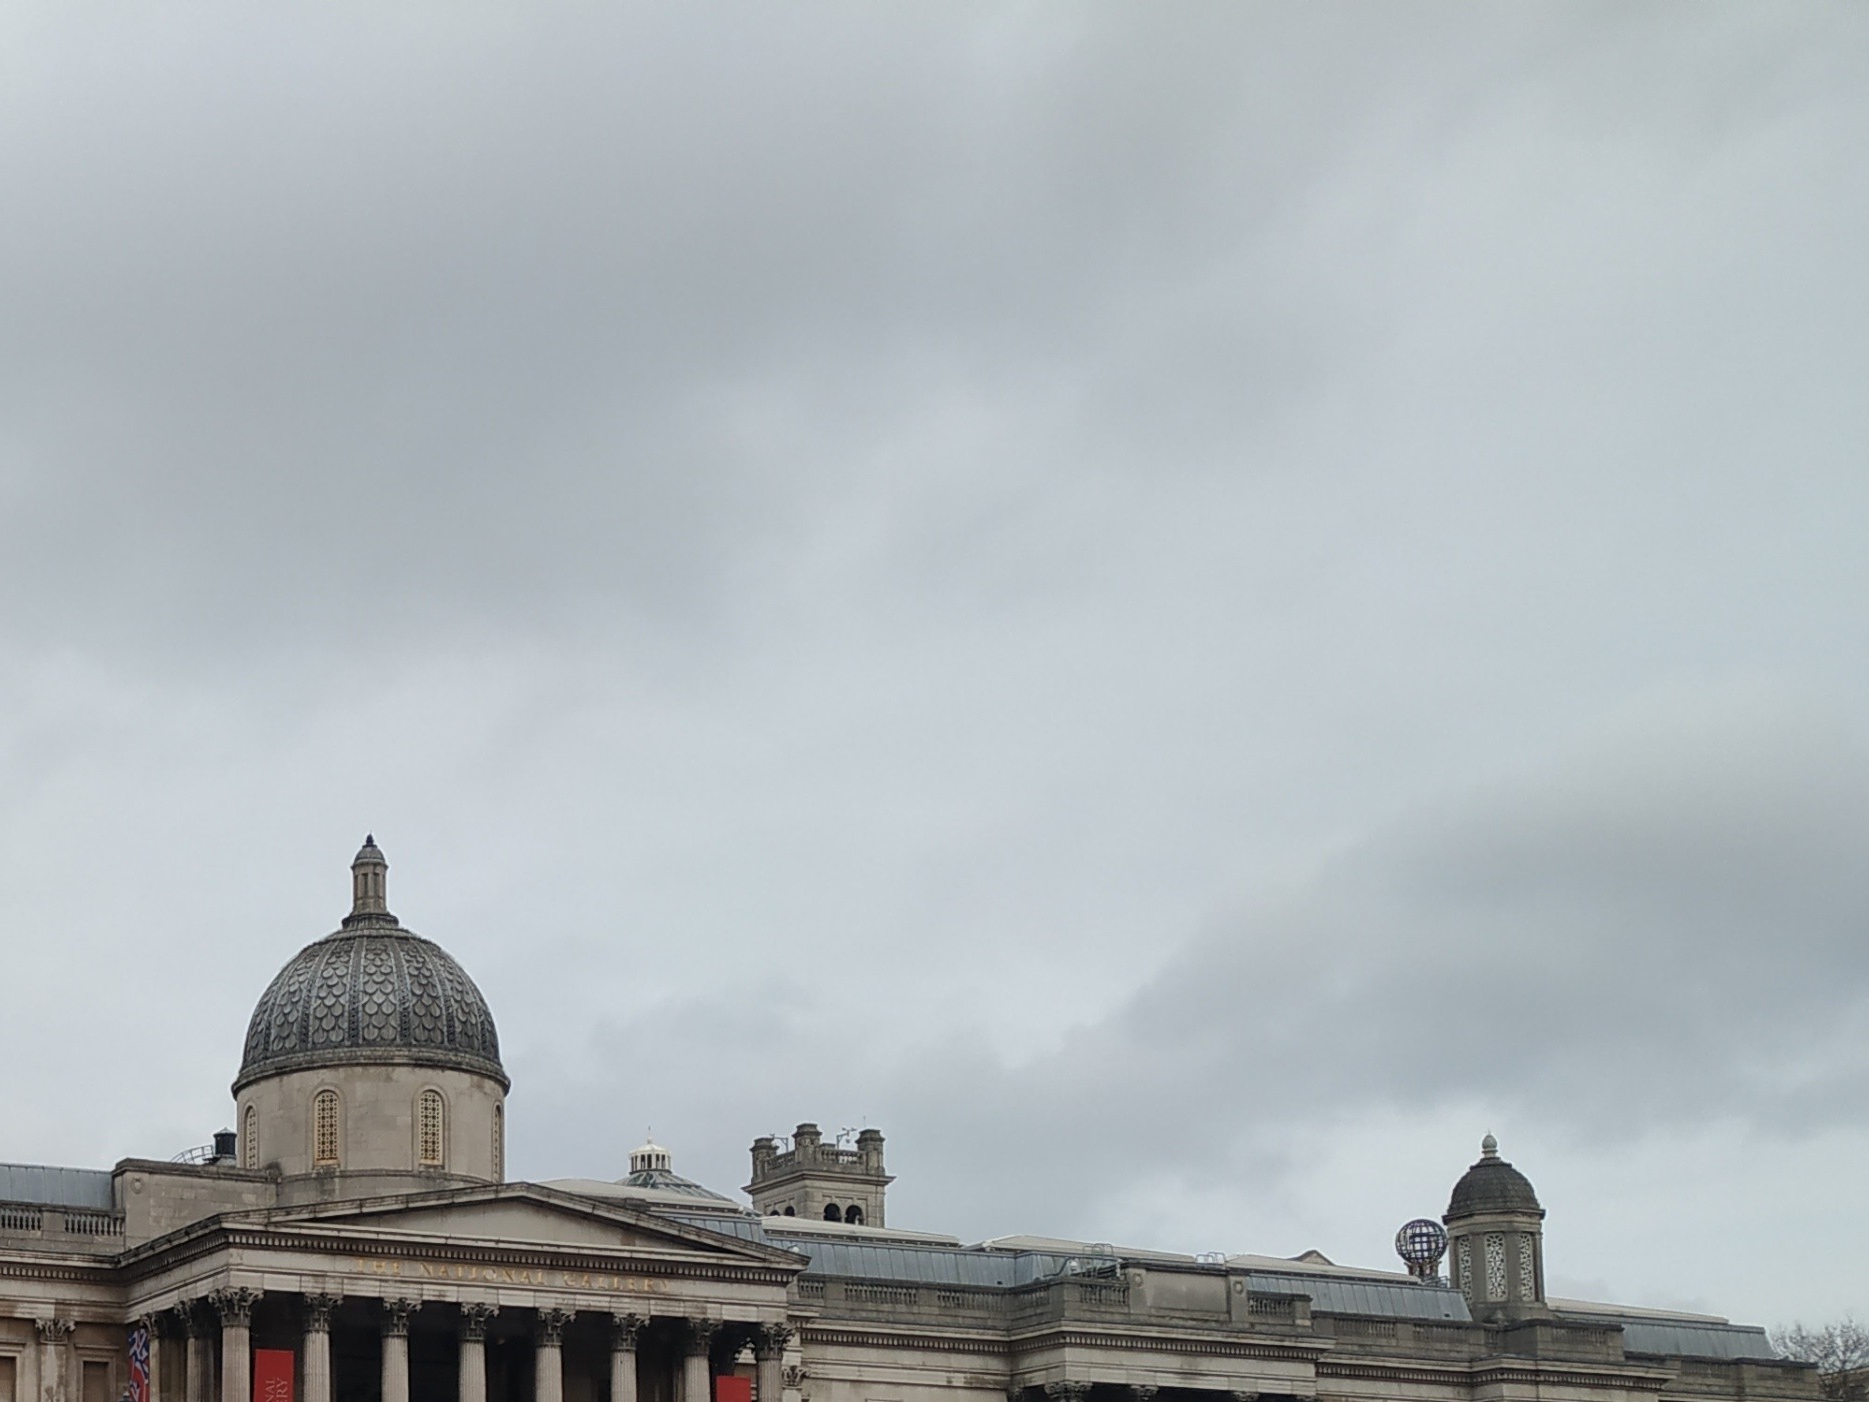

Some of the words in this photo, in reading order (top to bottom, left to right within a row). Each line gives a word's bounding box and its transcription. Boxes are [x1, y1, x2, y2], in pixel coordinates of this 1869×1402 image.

[357, 1258, 400, 1276] THE
[421, 1262, 546, 1285] NATIONAL
[562, 1270, 671, 1292] GALLERY
